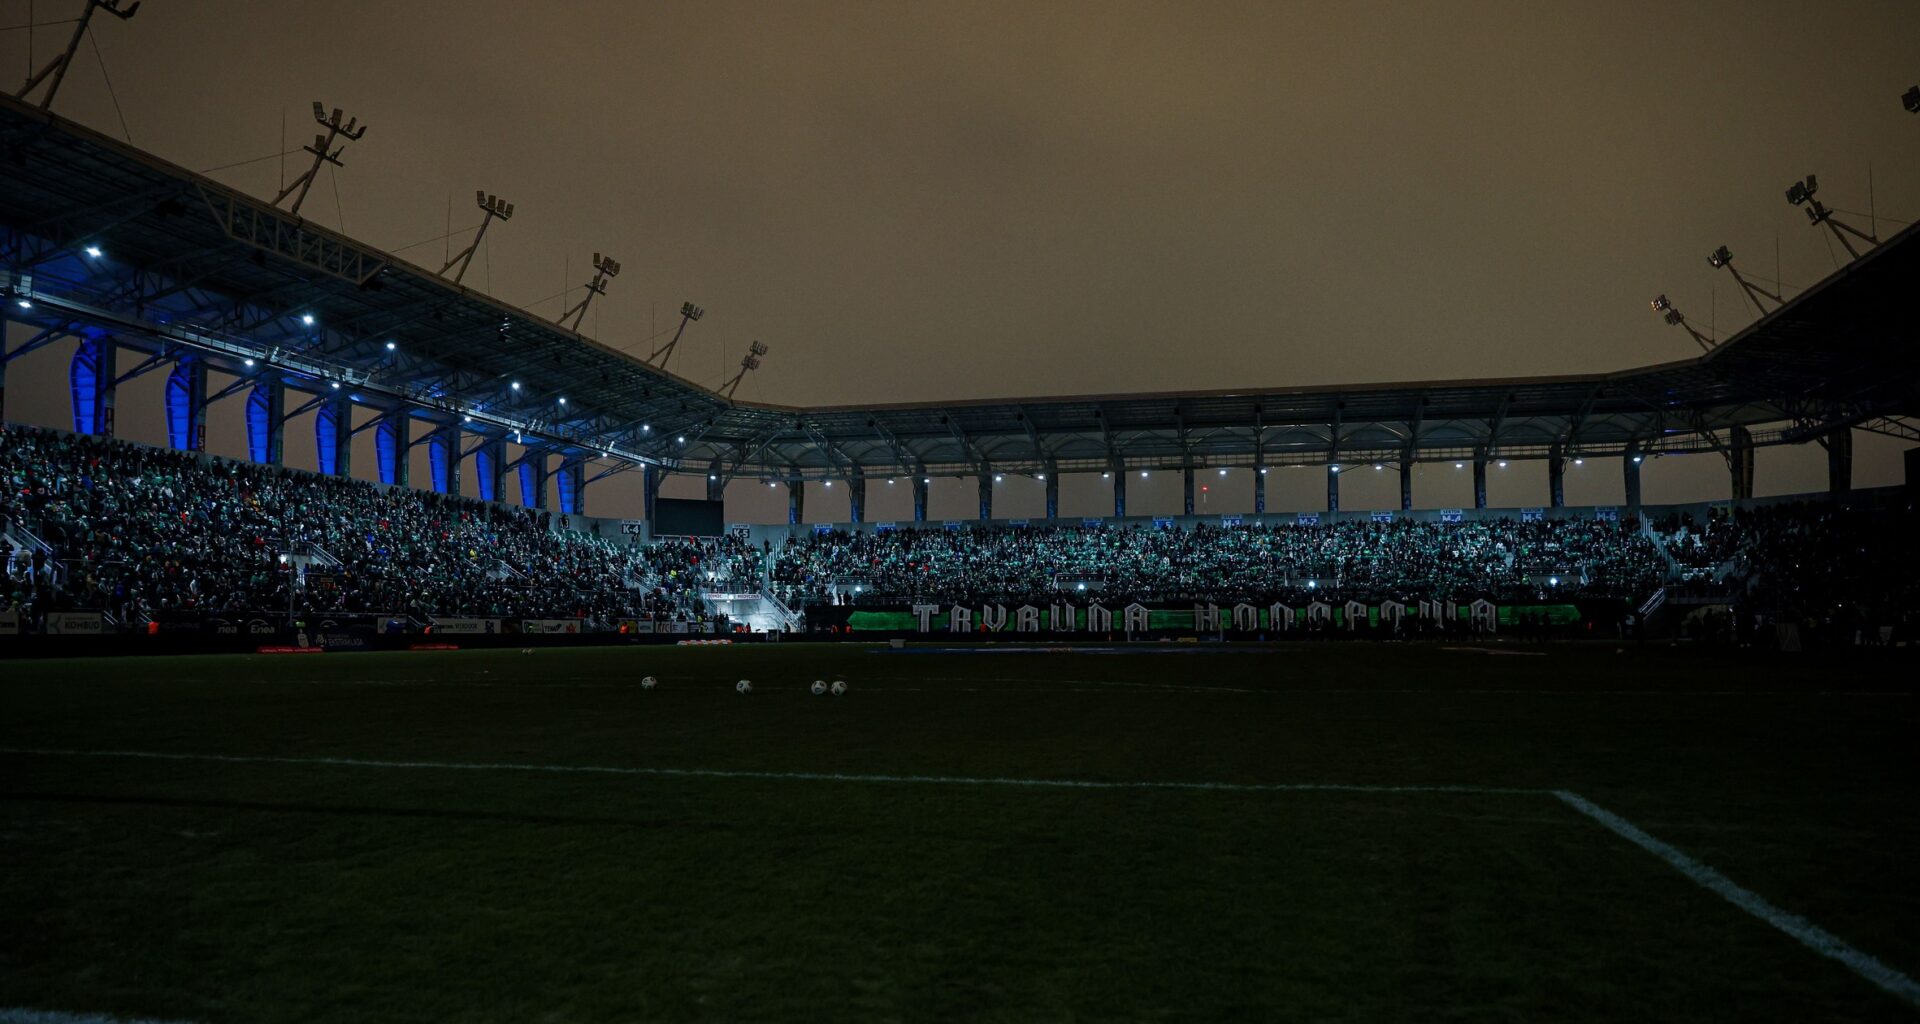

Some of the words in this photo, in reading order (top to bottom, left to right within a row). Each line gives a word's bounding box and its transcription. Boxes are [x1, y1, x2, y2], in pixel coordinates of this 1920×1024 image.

[622, 525, 640, 534] K-4
[734, 528, 748, 537] K-5
[250, 624, 275, 634] Enea
